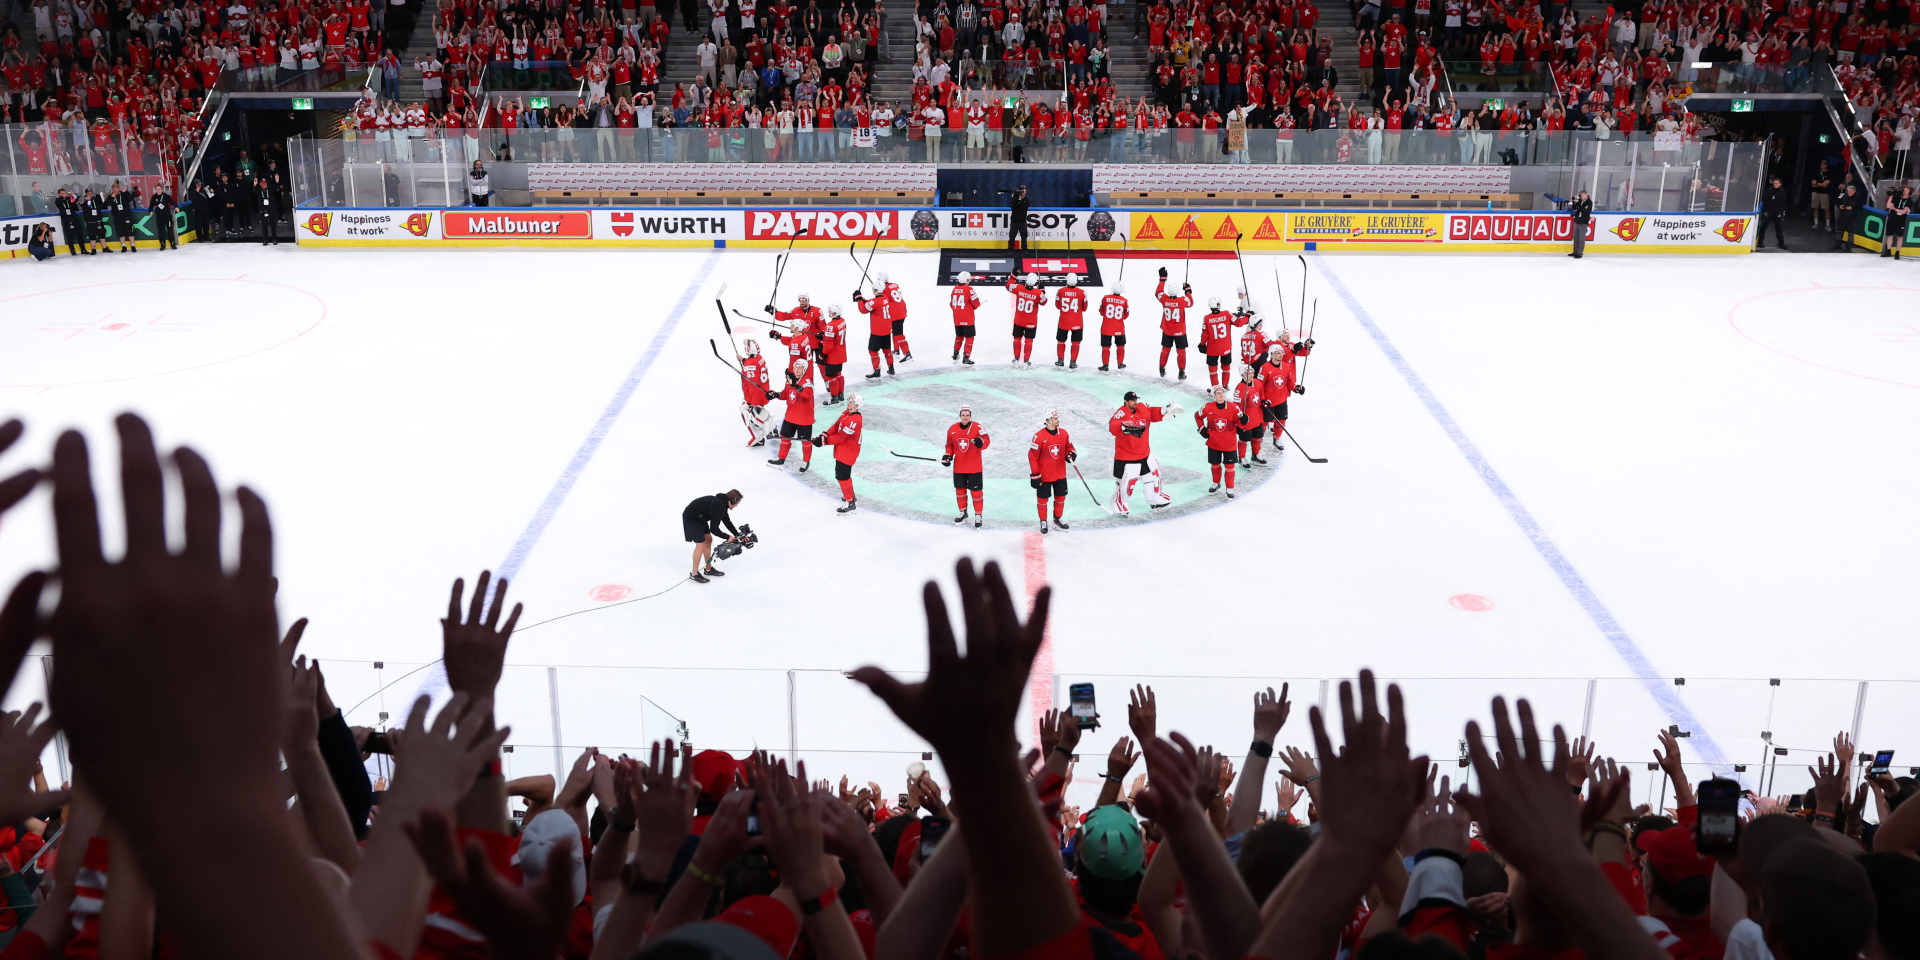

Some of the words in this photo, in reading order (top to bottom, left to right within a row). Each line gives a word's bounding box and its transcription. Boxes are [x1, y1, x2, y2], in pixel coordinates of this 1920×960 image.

[860, 128, 870, 137] 18
[341, 214, 391, 225] Happiness
[468, 216, 561, 234] Malbuner
[753, 212, 891, 238] PATRON
[987, 214, 1076, 229] TISOT
[1294, 216, 1305, 227] LE
[1308, 214, 1352, 227] GRUYÈRE
[1367, 216, 1378, 227] LE
[1381, 215, 1425, 228] GRUYÈRE
[1653, 218, 1706, 230] Happiness
[1140, 224, 1160, 238] Sika
[1178, 224, 1199, 238] Sika
[1217, 225, 1238, 238] Sika
[1256, 225, 1277, 238] Sika
[952, 295, 965, 309] 44
[1018, 298, 1034, 313] 80
[1061, 298, 1079, 313] 54
[1105, 304, 1124, 320] 88
[1164, 308, 1181, 322] 94
[1212, 323, 1227, 339] 13
[850, 421, 857, 429] 14
